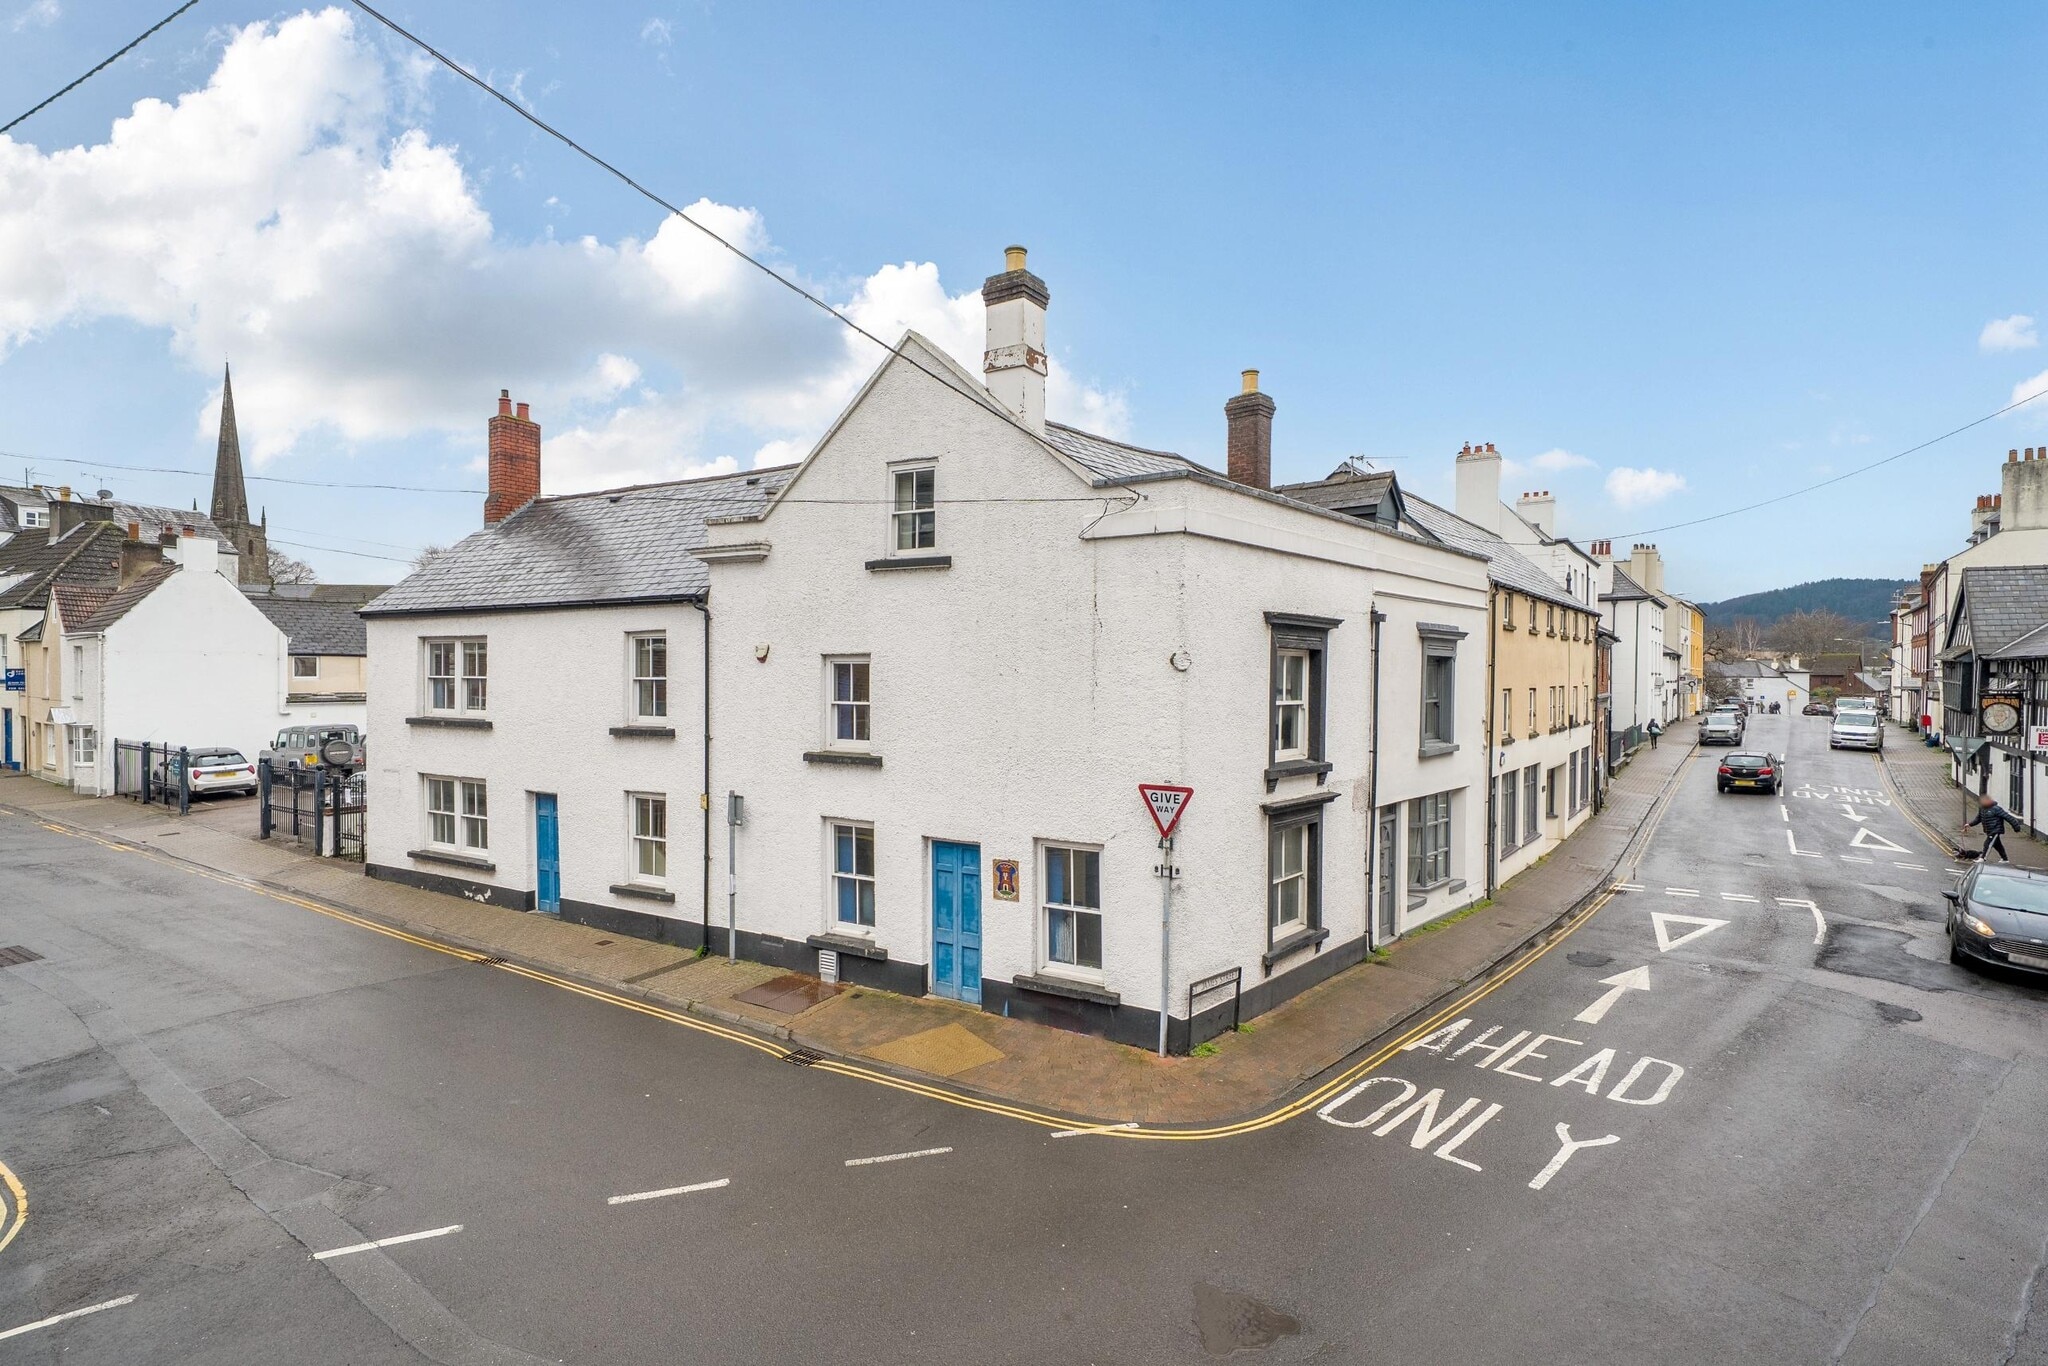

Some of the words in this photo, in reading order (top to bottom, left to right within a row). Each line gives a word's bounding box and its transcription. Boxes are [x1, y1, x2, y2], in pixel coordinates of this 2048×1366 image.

[1150, 792, 1180, 805] GIVE
[1792, 790, 1891, 806] AHEAD
[1156, 805, 1175, 814] WAY
[1402, 1018, 1685, 1106] AHEAD
